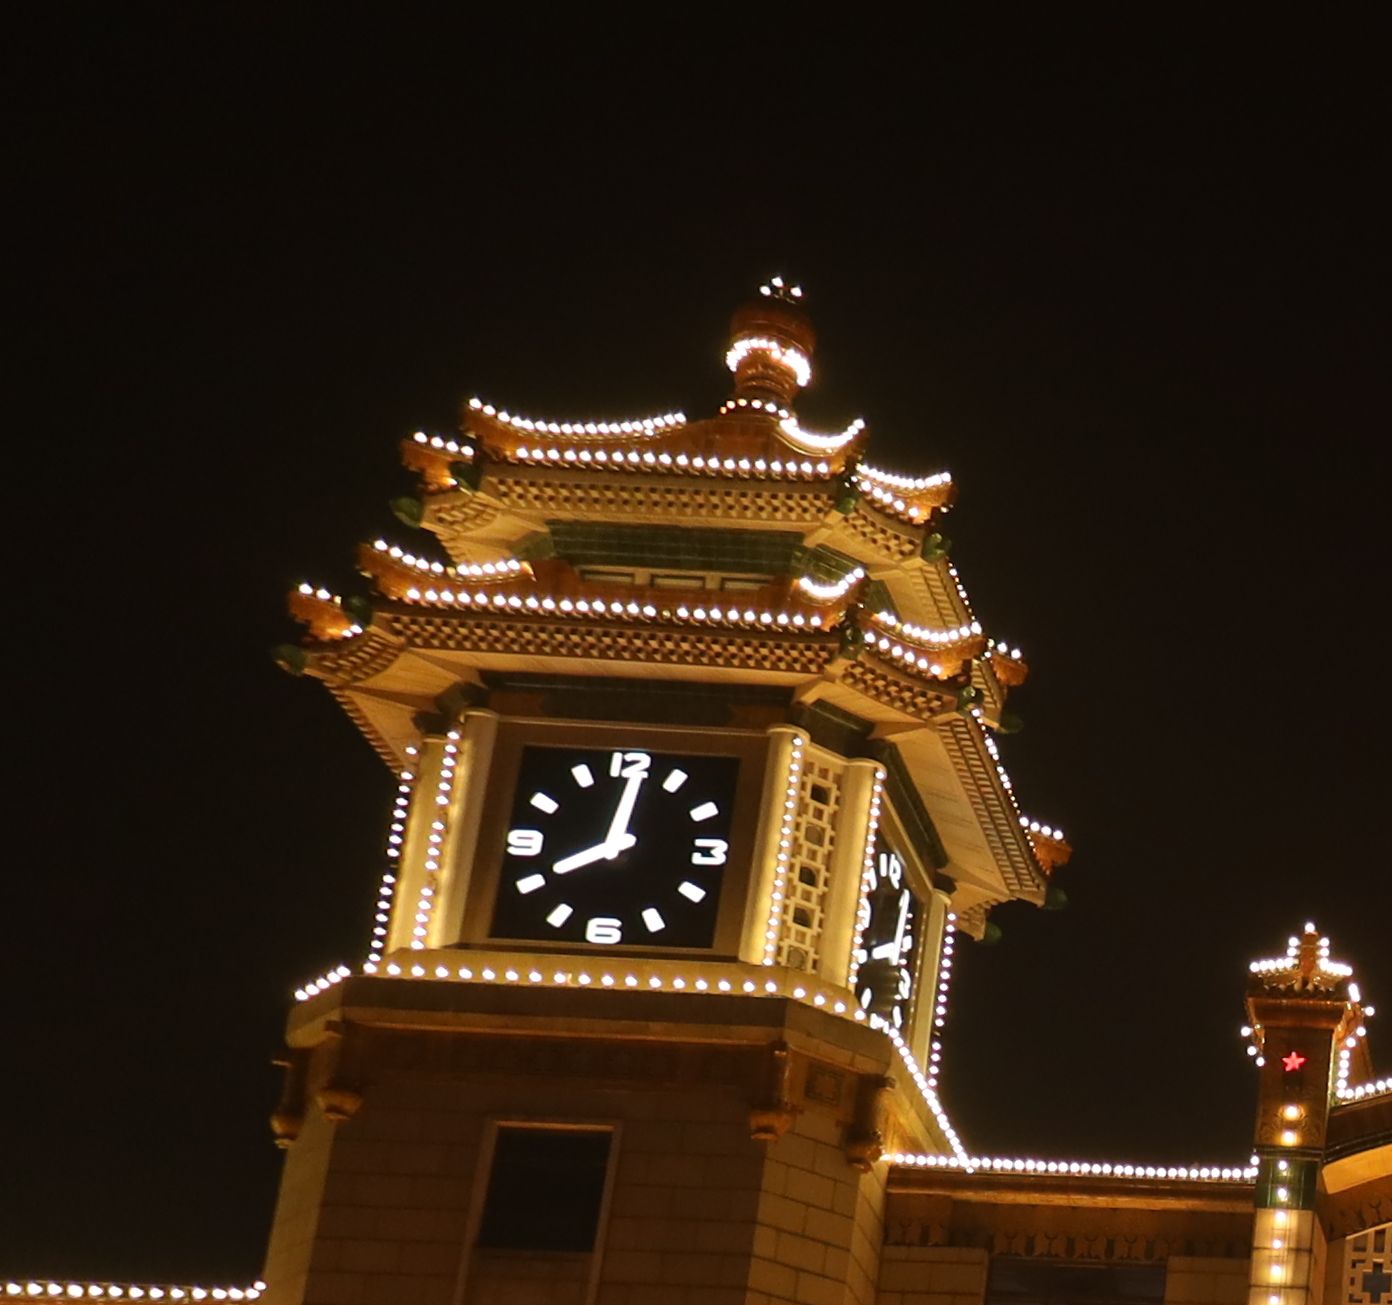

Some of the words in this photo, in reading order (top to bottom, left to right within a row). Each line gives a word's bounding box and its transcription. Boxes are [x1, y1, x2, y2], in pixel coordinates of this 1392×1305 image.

[610, 752, 651, 778] 12
[507, 829, 544, 856] 9
[691, 838, 728, 865] 3
[585, 917, 622, 944] 6
